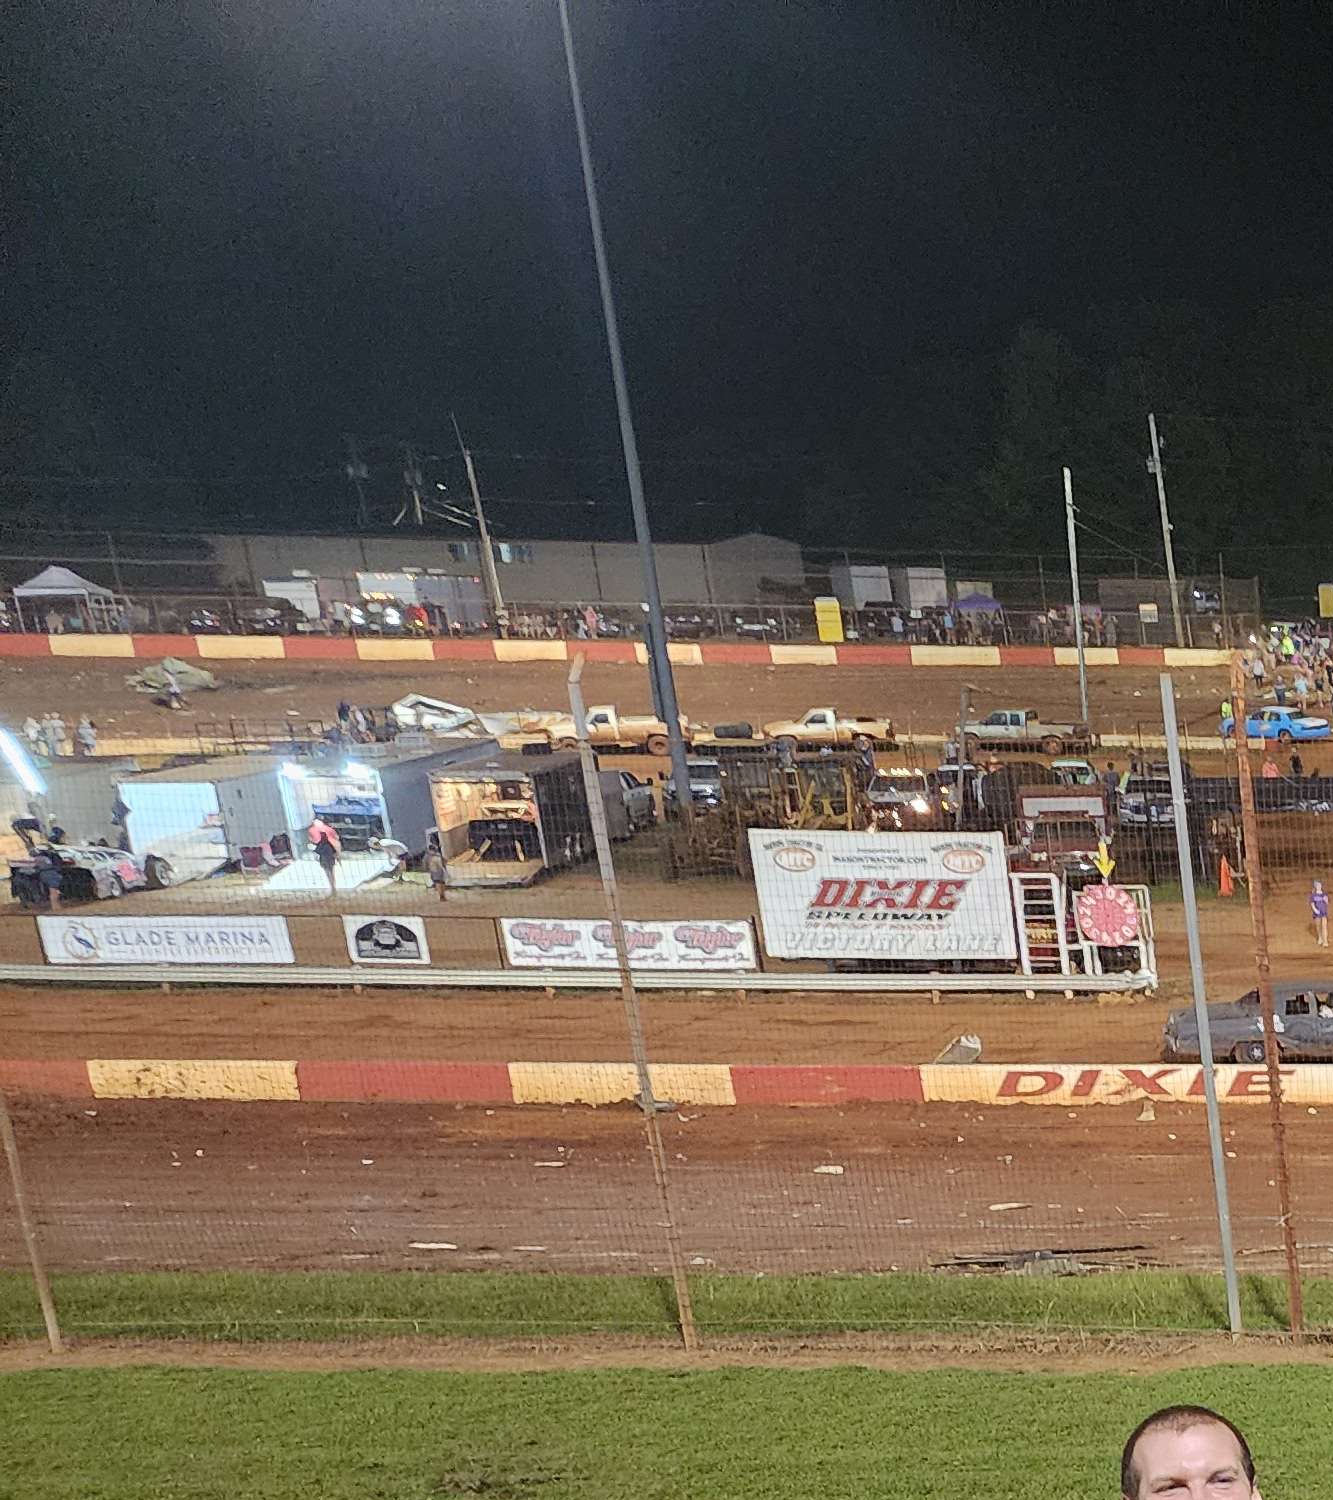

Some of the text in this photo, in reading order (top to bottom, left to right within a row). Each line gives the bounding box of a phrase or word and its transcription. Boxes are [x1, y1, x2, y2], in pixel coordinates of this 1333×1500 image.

[810, 878, 968, 911] DIXIE
[806, 911, 953, 921] SPEEDWAY
[106, 931, 272, 947] GLADE MARINA
[784, 931, 1002, 951] VICTORY LANE
[996, 1069, 1295, 1098] DIXIE
